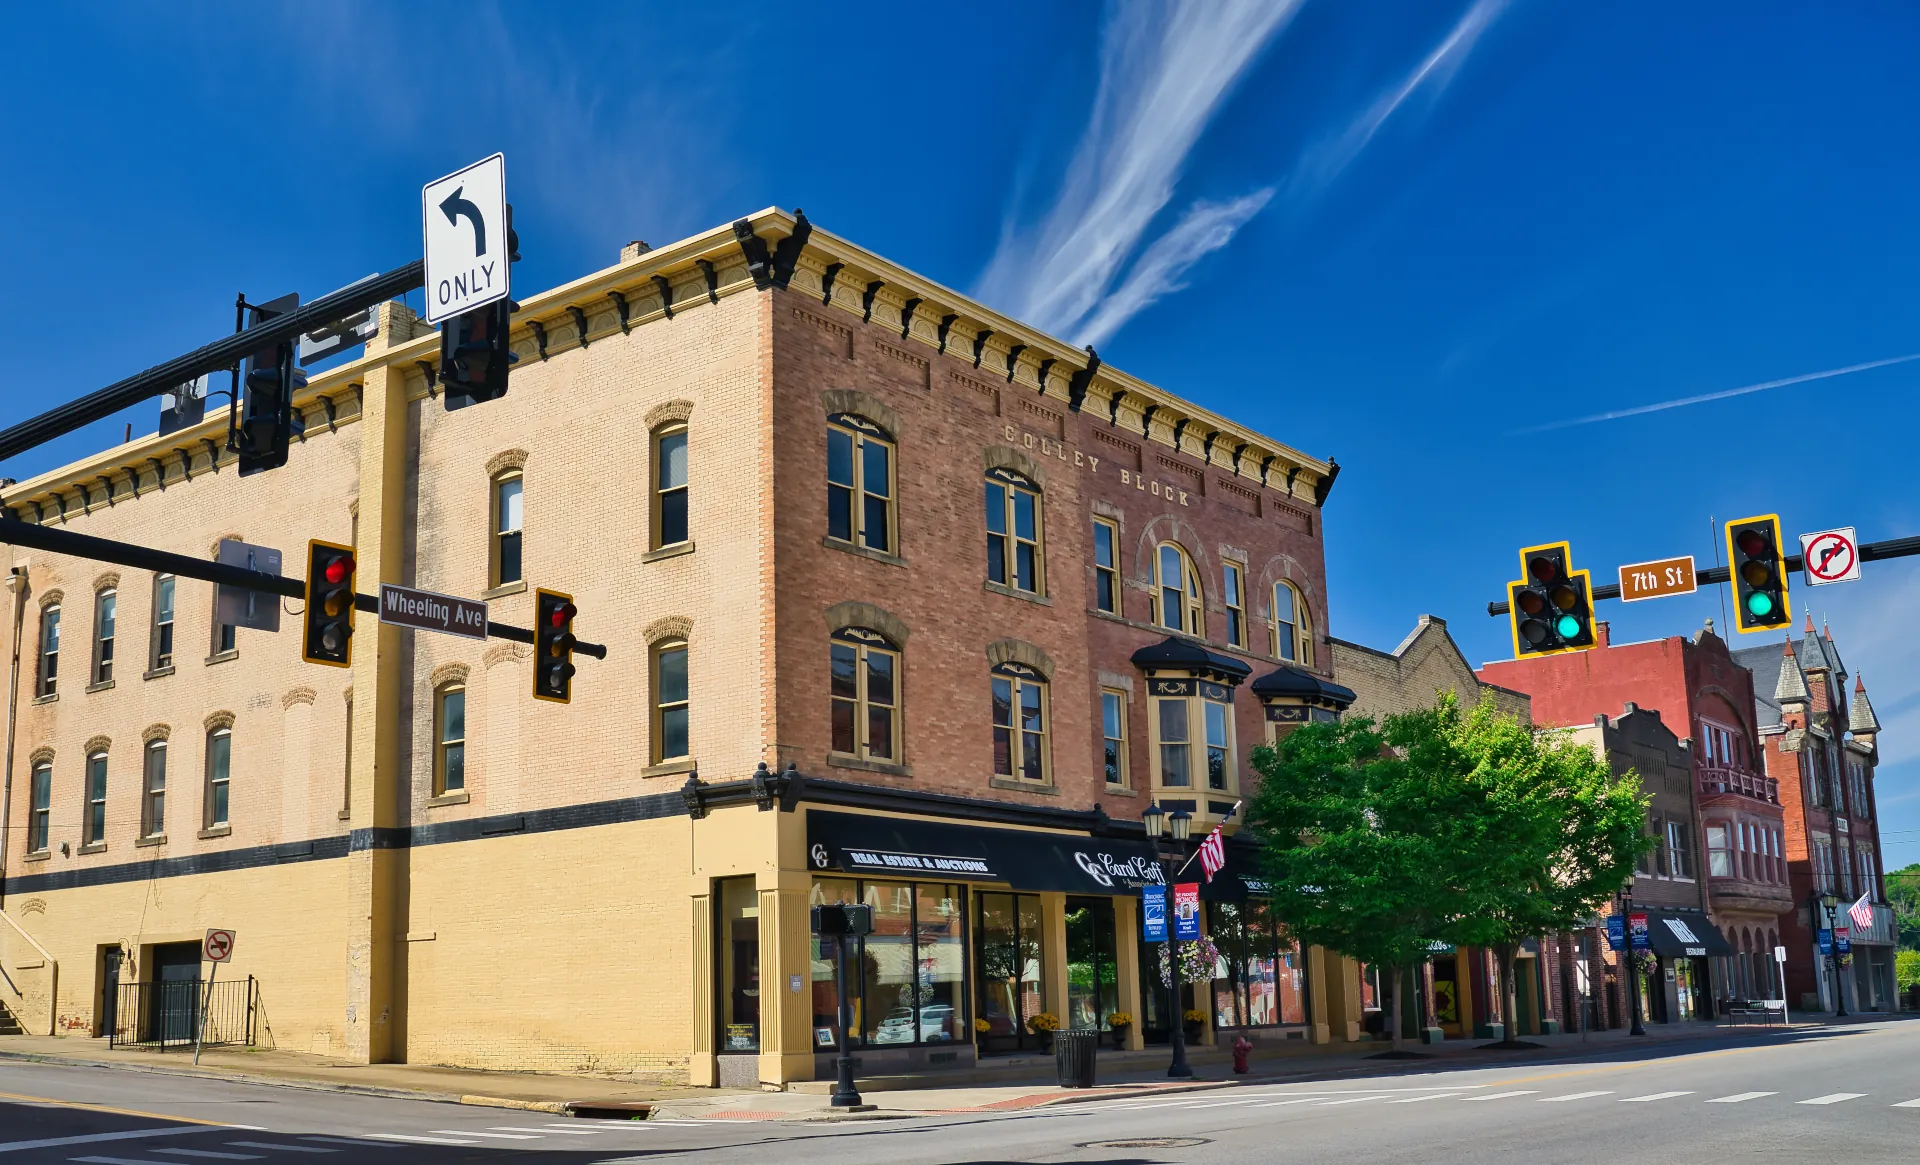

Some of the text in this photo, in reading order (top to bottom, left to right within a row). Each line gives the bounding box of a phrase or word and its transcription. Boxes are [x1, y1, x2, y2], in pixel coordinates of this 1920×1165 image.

[439, 261, 495, 306] ONLY
[1005, 425, 1189, 507] COLLEY BLOCK
[1632, 567, 1684, 592] 7th St
[386, 590, 482, 627] Wheeling Ave
[850, 852, 988, 872] REAL ESTATE & AUCTIONS
[1097, 853, 1166, 886] Carol Goff
